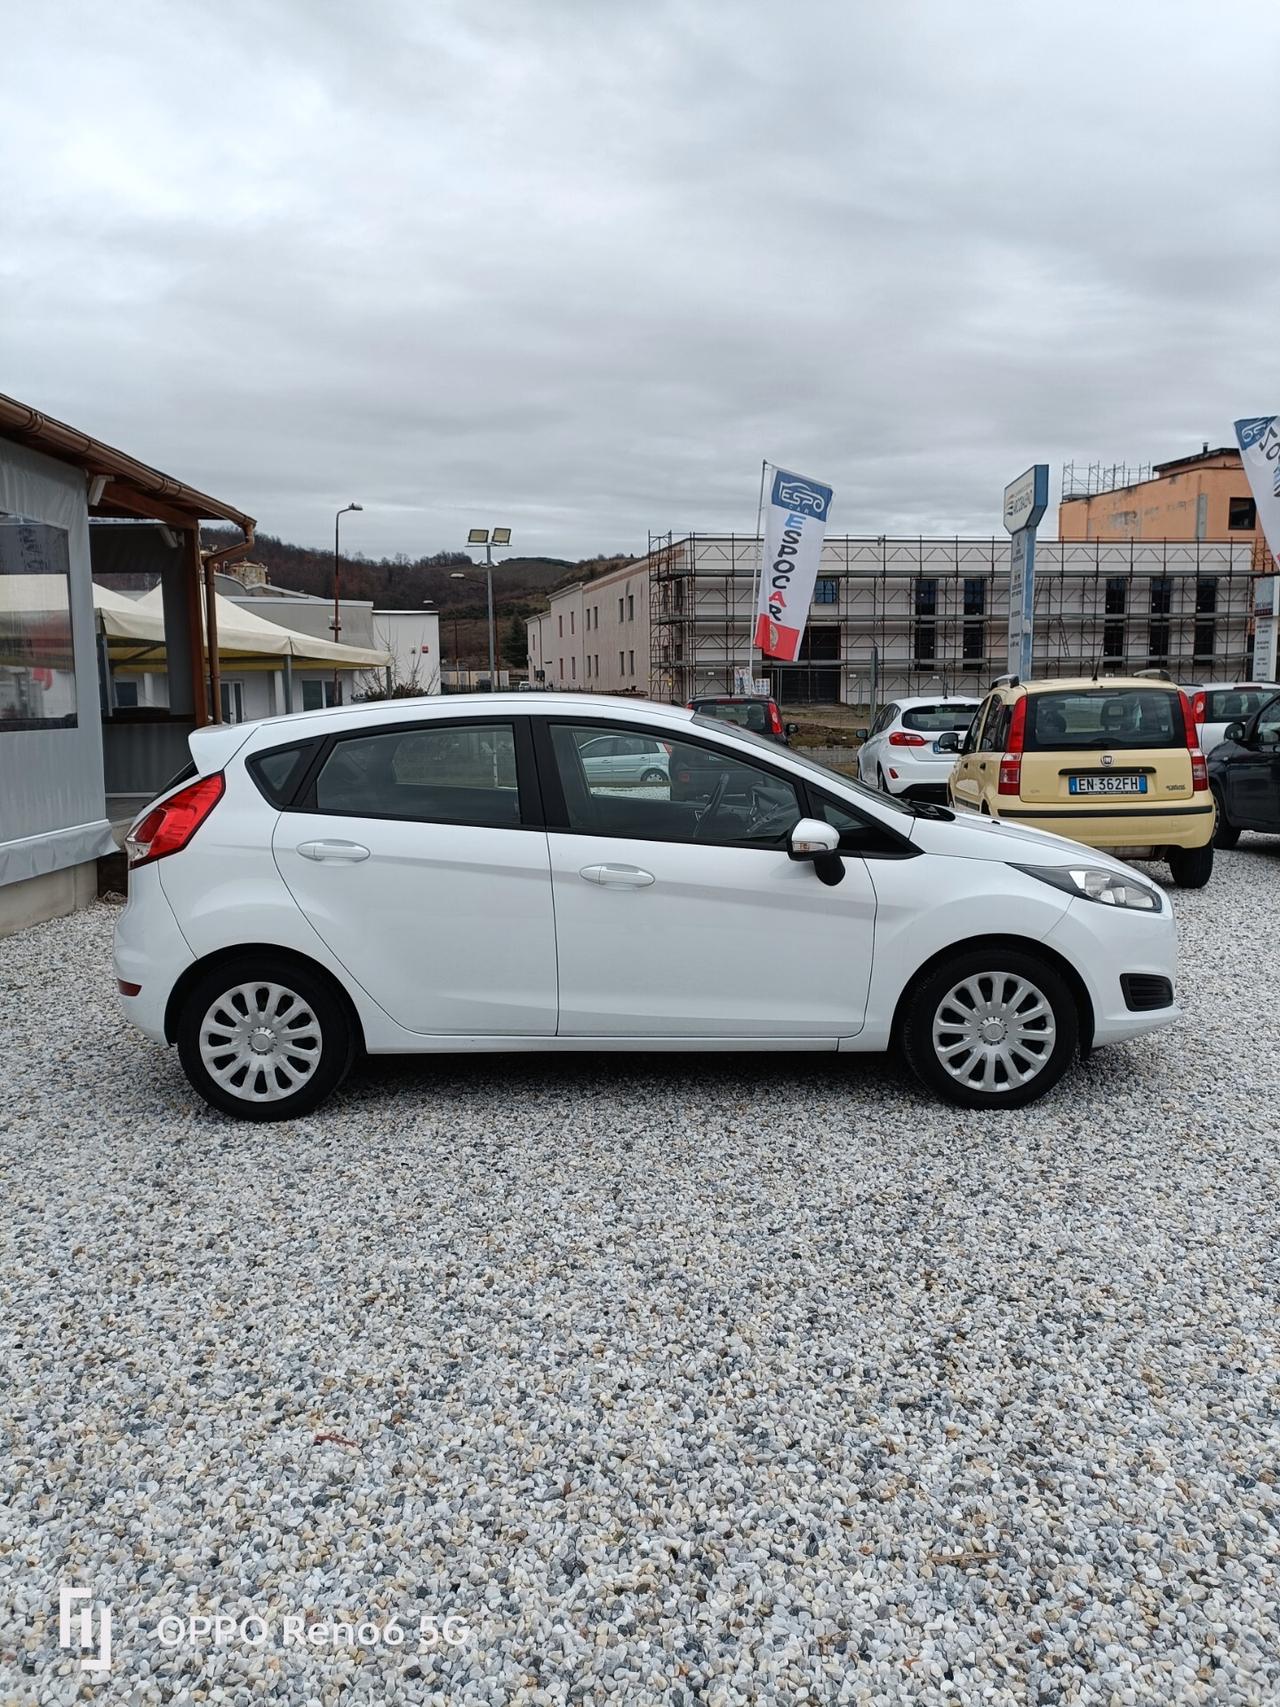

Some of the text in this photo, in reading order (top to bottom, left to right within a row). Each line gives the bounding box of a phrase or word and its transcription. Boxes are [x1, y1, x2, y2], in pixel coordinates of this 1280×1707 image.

[780, 488, 825, 513] ESPO
[768, 512, 807, 622] ESPOCAR
[1078, 777, 1138, 791] EN 362FH
